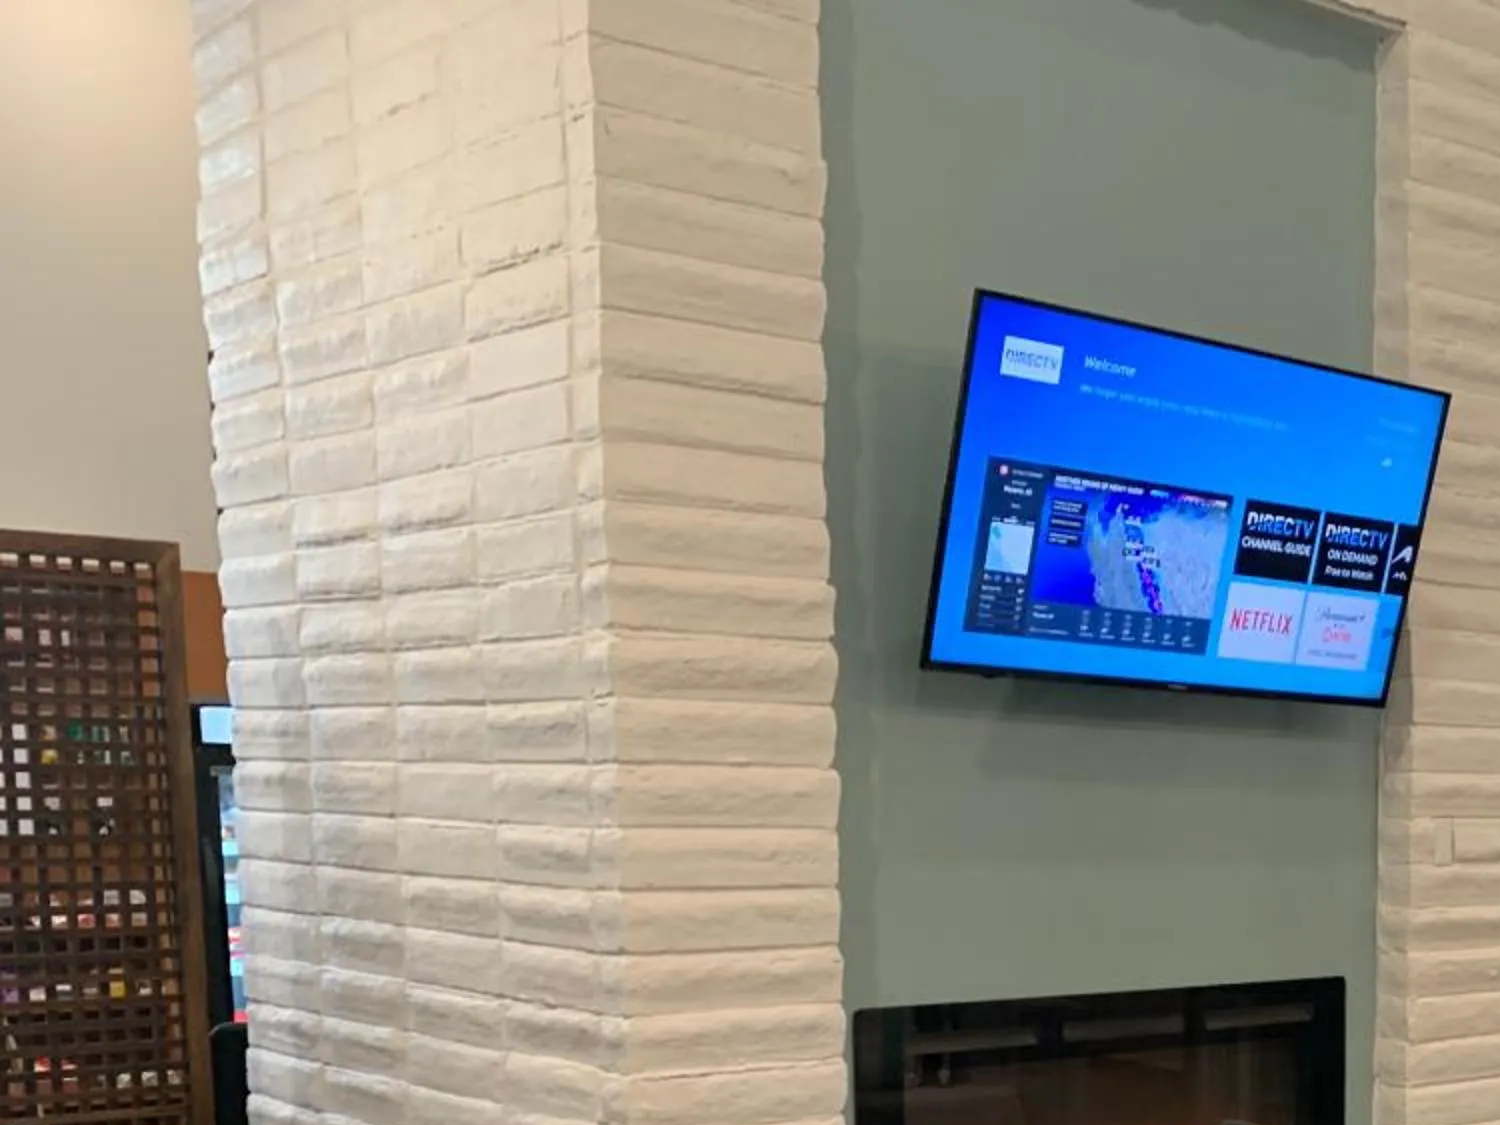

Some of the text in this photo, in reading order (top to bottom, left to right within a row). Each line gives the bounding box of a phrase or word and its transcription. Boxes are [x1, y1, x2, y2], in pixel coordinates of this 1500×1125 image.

[1006, 347, 1058, 371] DIRECTV
[1084, 354, 1136, 378] Welcome
[1247, 511, 1315, 540] DIRECTV
[1325, 523, 1388, 551] DIRECTV
[1241, 535, 1312, 558] CHANNEL GUIDE
[1327, 548, 1340, 561] ON
[1341, 550, 1378, 567] DEMAND
[1229, 607, 1294, 636] NETFLIX
